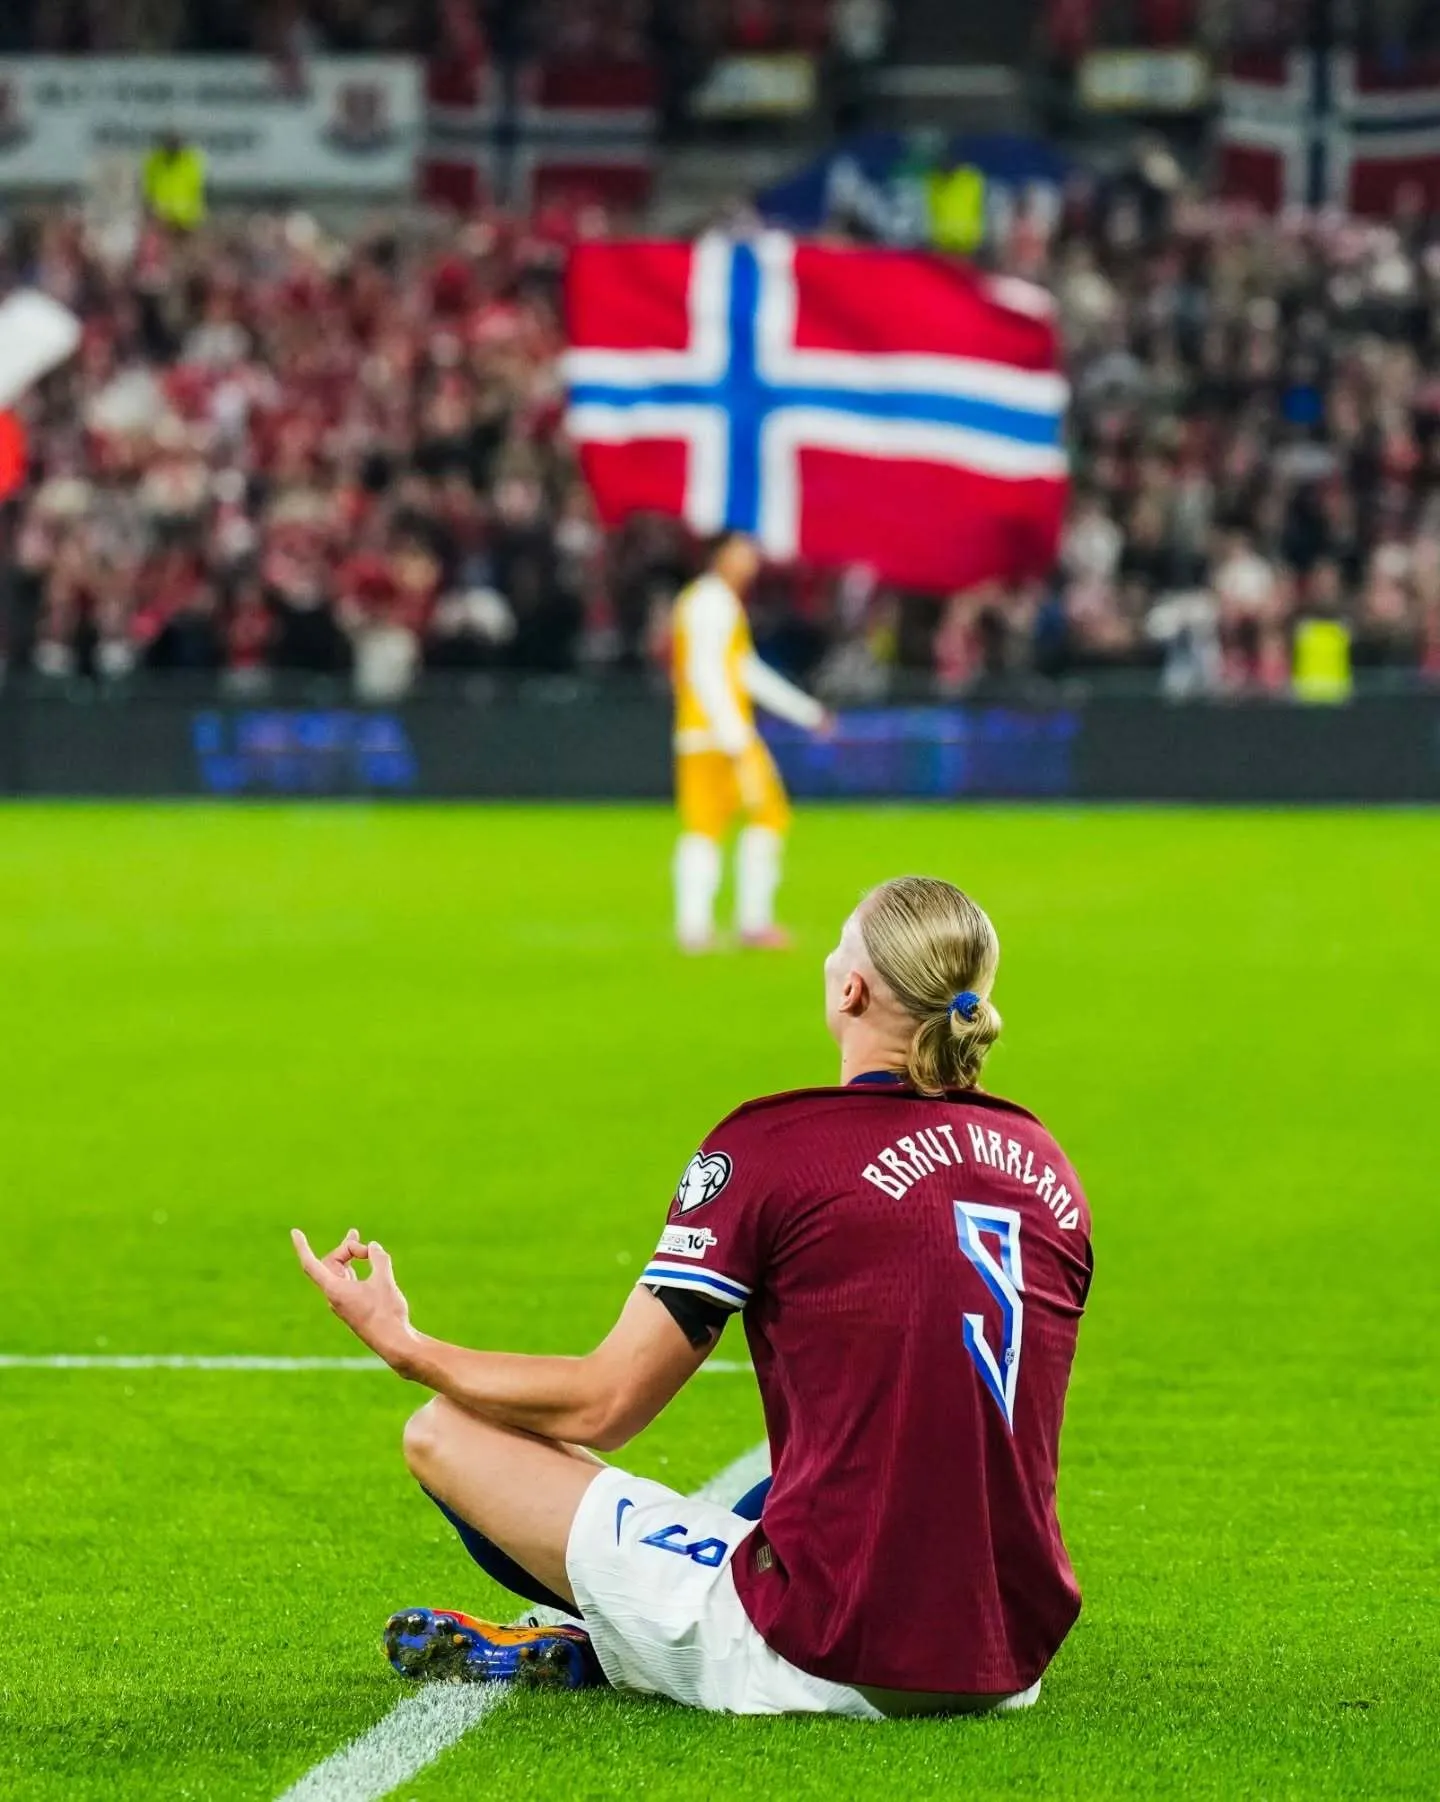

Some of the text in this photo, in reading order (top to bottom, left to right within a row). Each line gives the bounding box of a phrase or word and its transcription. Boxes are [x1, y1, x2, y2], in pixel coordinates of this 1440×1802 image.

[861, 1122, 1081, 1230] BRAUT HAALAND
[952, 1199, 1026, 1437] 9
